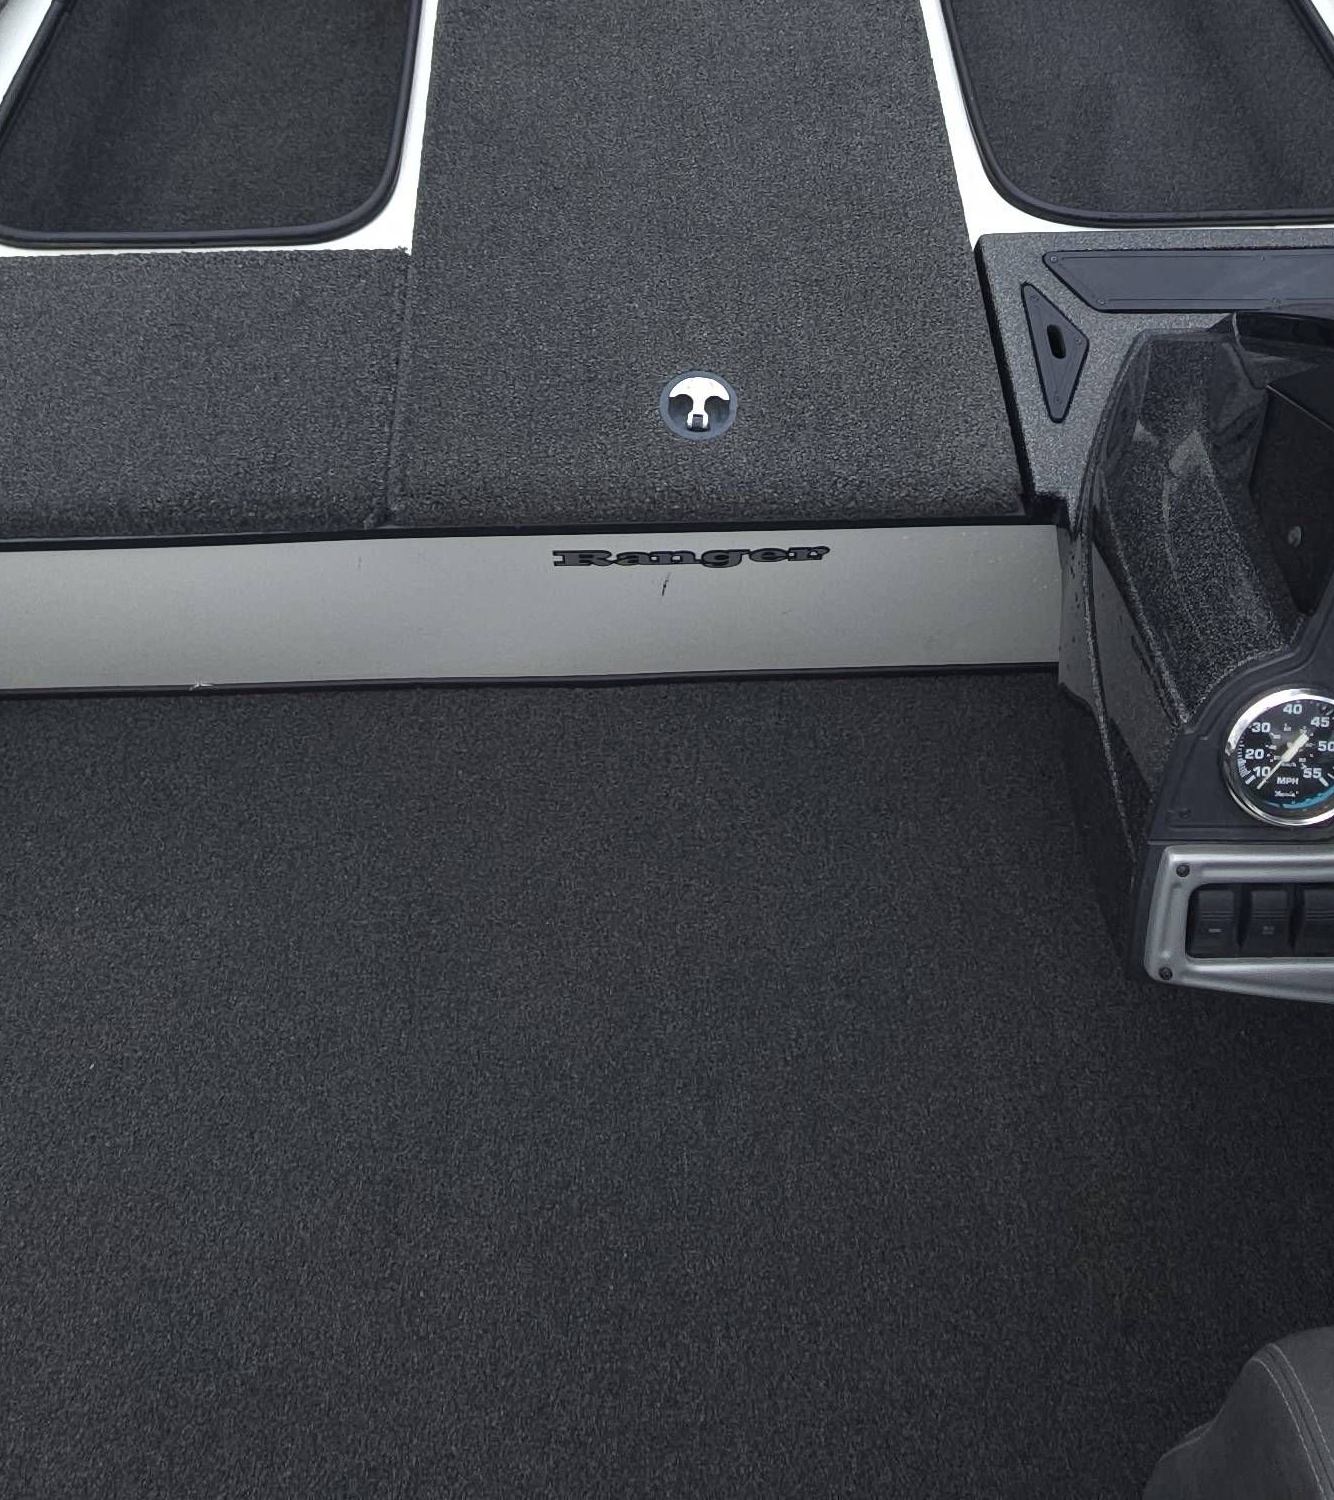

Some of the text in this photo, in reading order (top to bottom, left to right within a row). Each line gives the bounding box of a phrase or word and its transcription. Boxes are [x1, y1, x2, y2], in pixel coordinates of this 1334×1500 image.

[552, 545, 831, 569] Ranger
[1283, 703, 1303, 715] 40
[1310, 716, 1330, 727] 45
[1251, 722, 1271, 733] 30
[1244, 748, 1264, 759] 20
[1253, 766, 1271, 778] 10
[1302, 768, 1323, 779] 55
[1276, 777, 1299, 785] MPH
